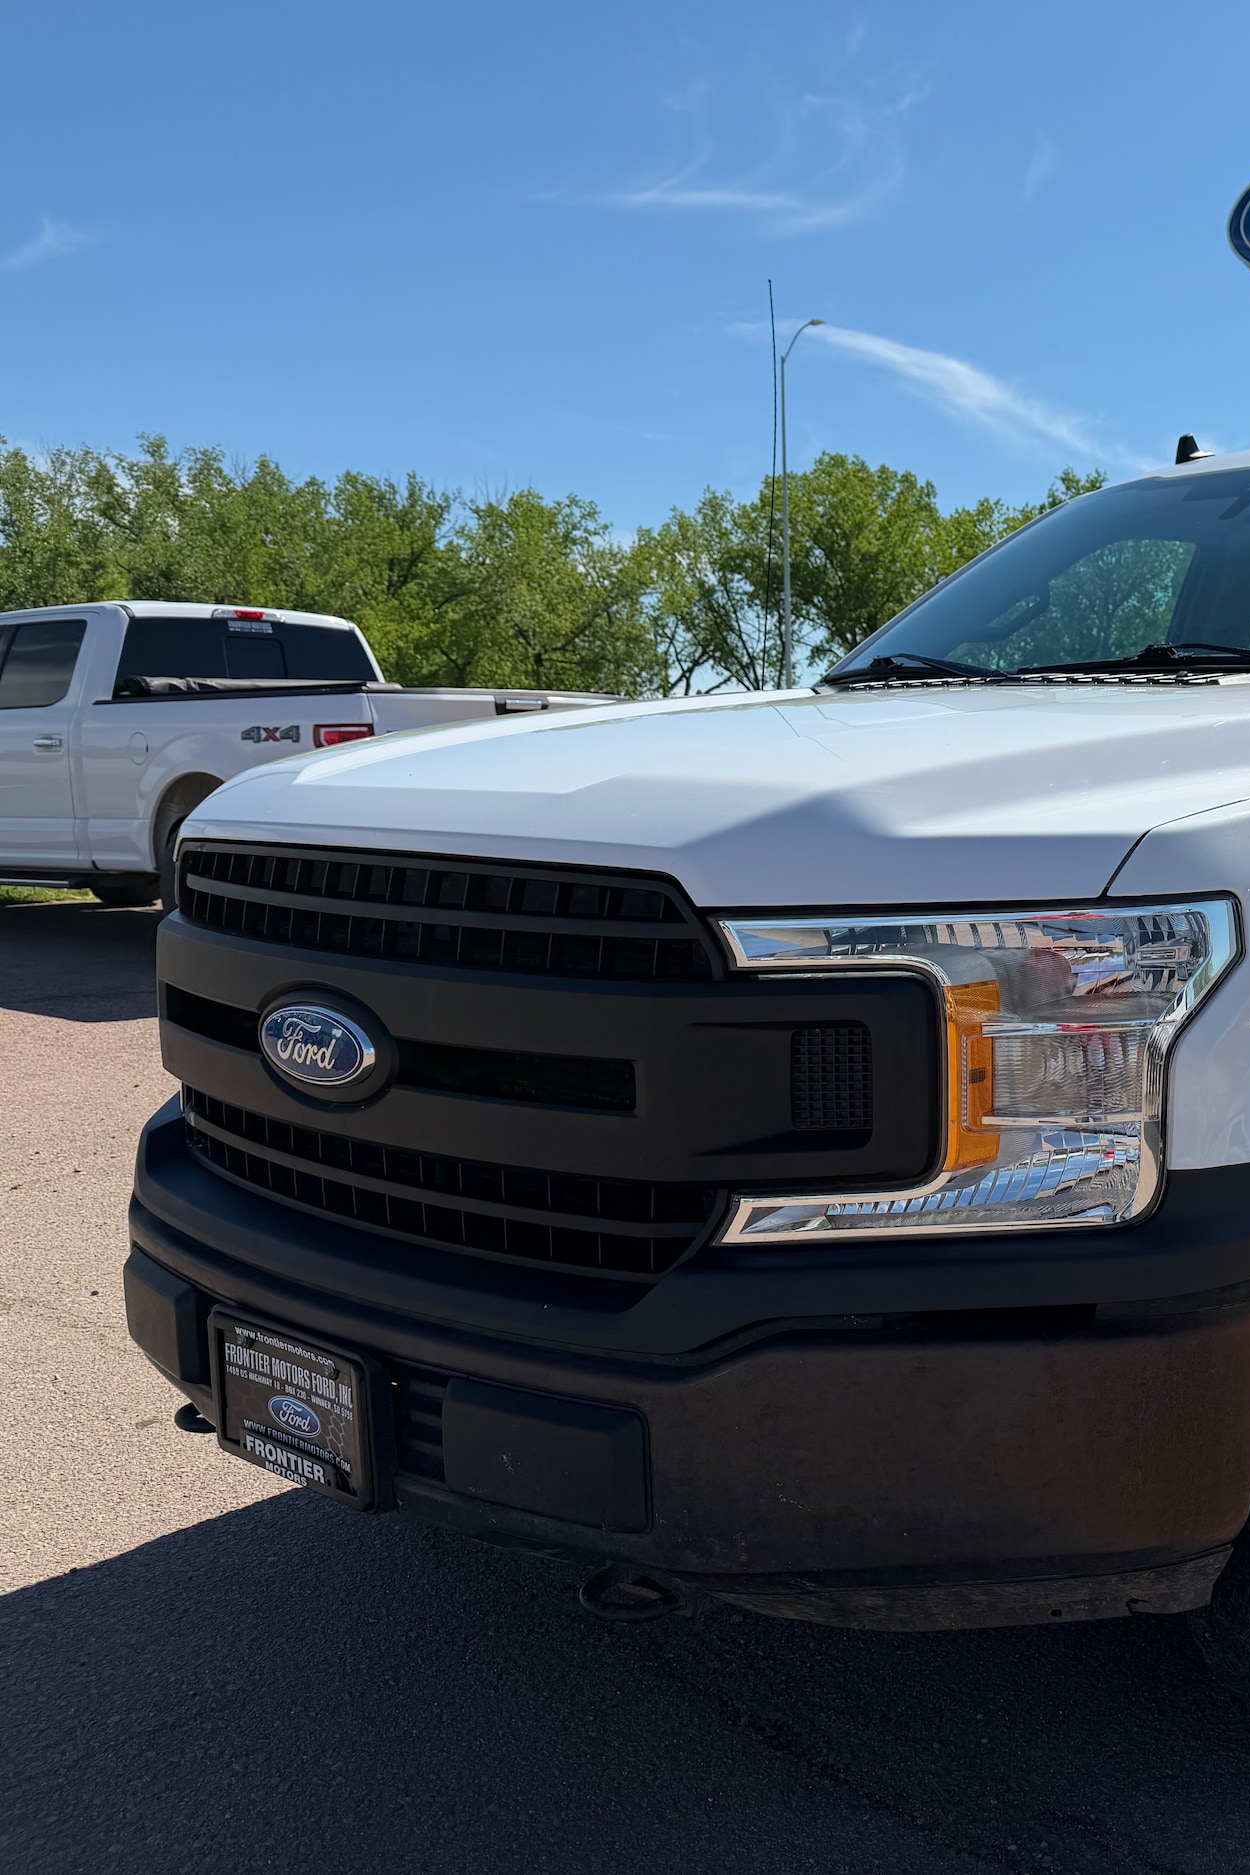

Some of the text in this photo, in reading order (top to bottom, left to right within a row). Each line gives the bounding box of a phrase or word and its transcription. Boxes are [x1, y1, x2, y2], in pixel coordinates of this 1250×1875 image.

[277, 1018, 336, 1069] Ford
[224, 1342, 270, 1375] FRONTIER
[271, 1357, 310, 1389] MOTORS
[234, 1326, 336, 1368] www.frontiermotors.com
[240, 1369, 248, 1379] US
[248, 1372, 273, 1387] HIGHWAY
[273, 1380, 281, 1390] 18
[284, 1384, 296, 1396] BOX
[296, 1389, 307, 1400] 230
[279, 1400, 312, 1432] Ford
[243, 1418, 352, 1474] WWW.FRONTIERMOTORS.COM
[246, 1434, 326, 1485] FRONTIER
[265, 1461, 308, 1487] MOTORS
